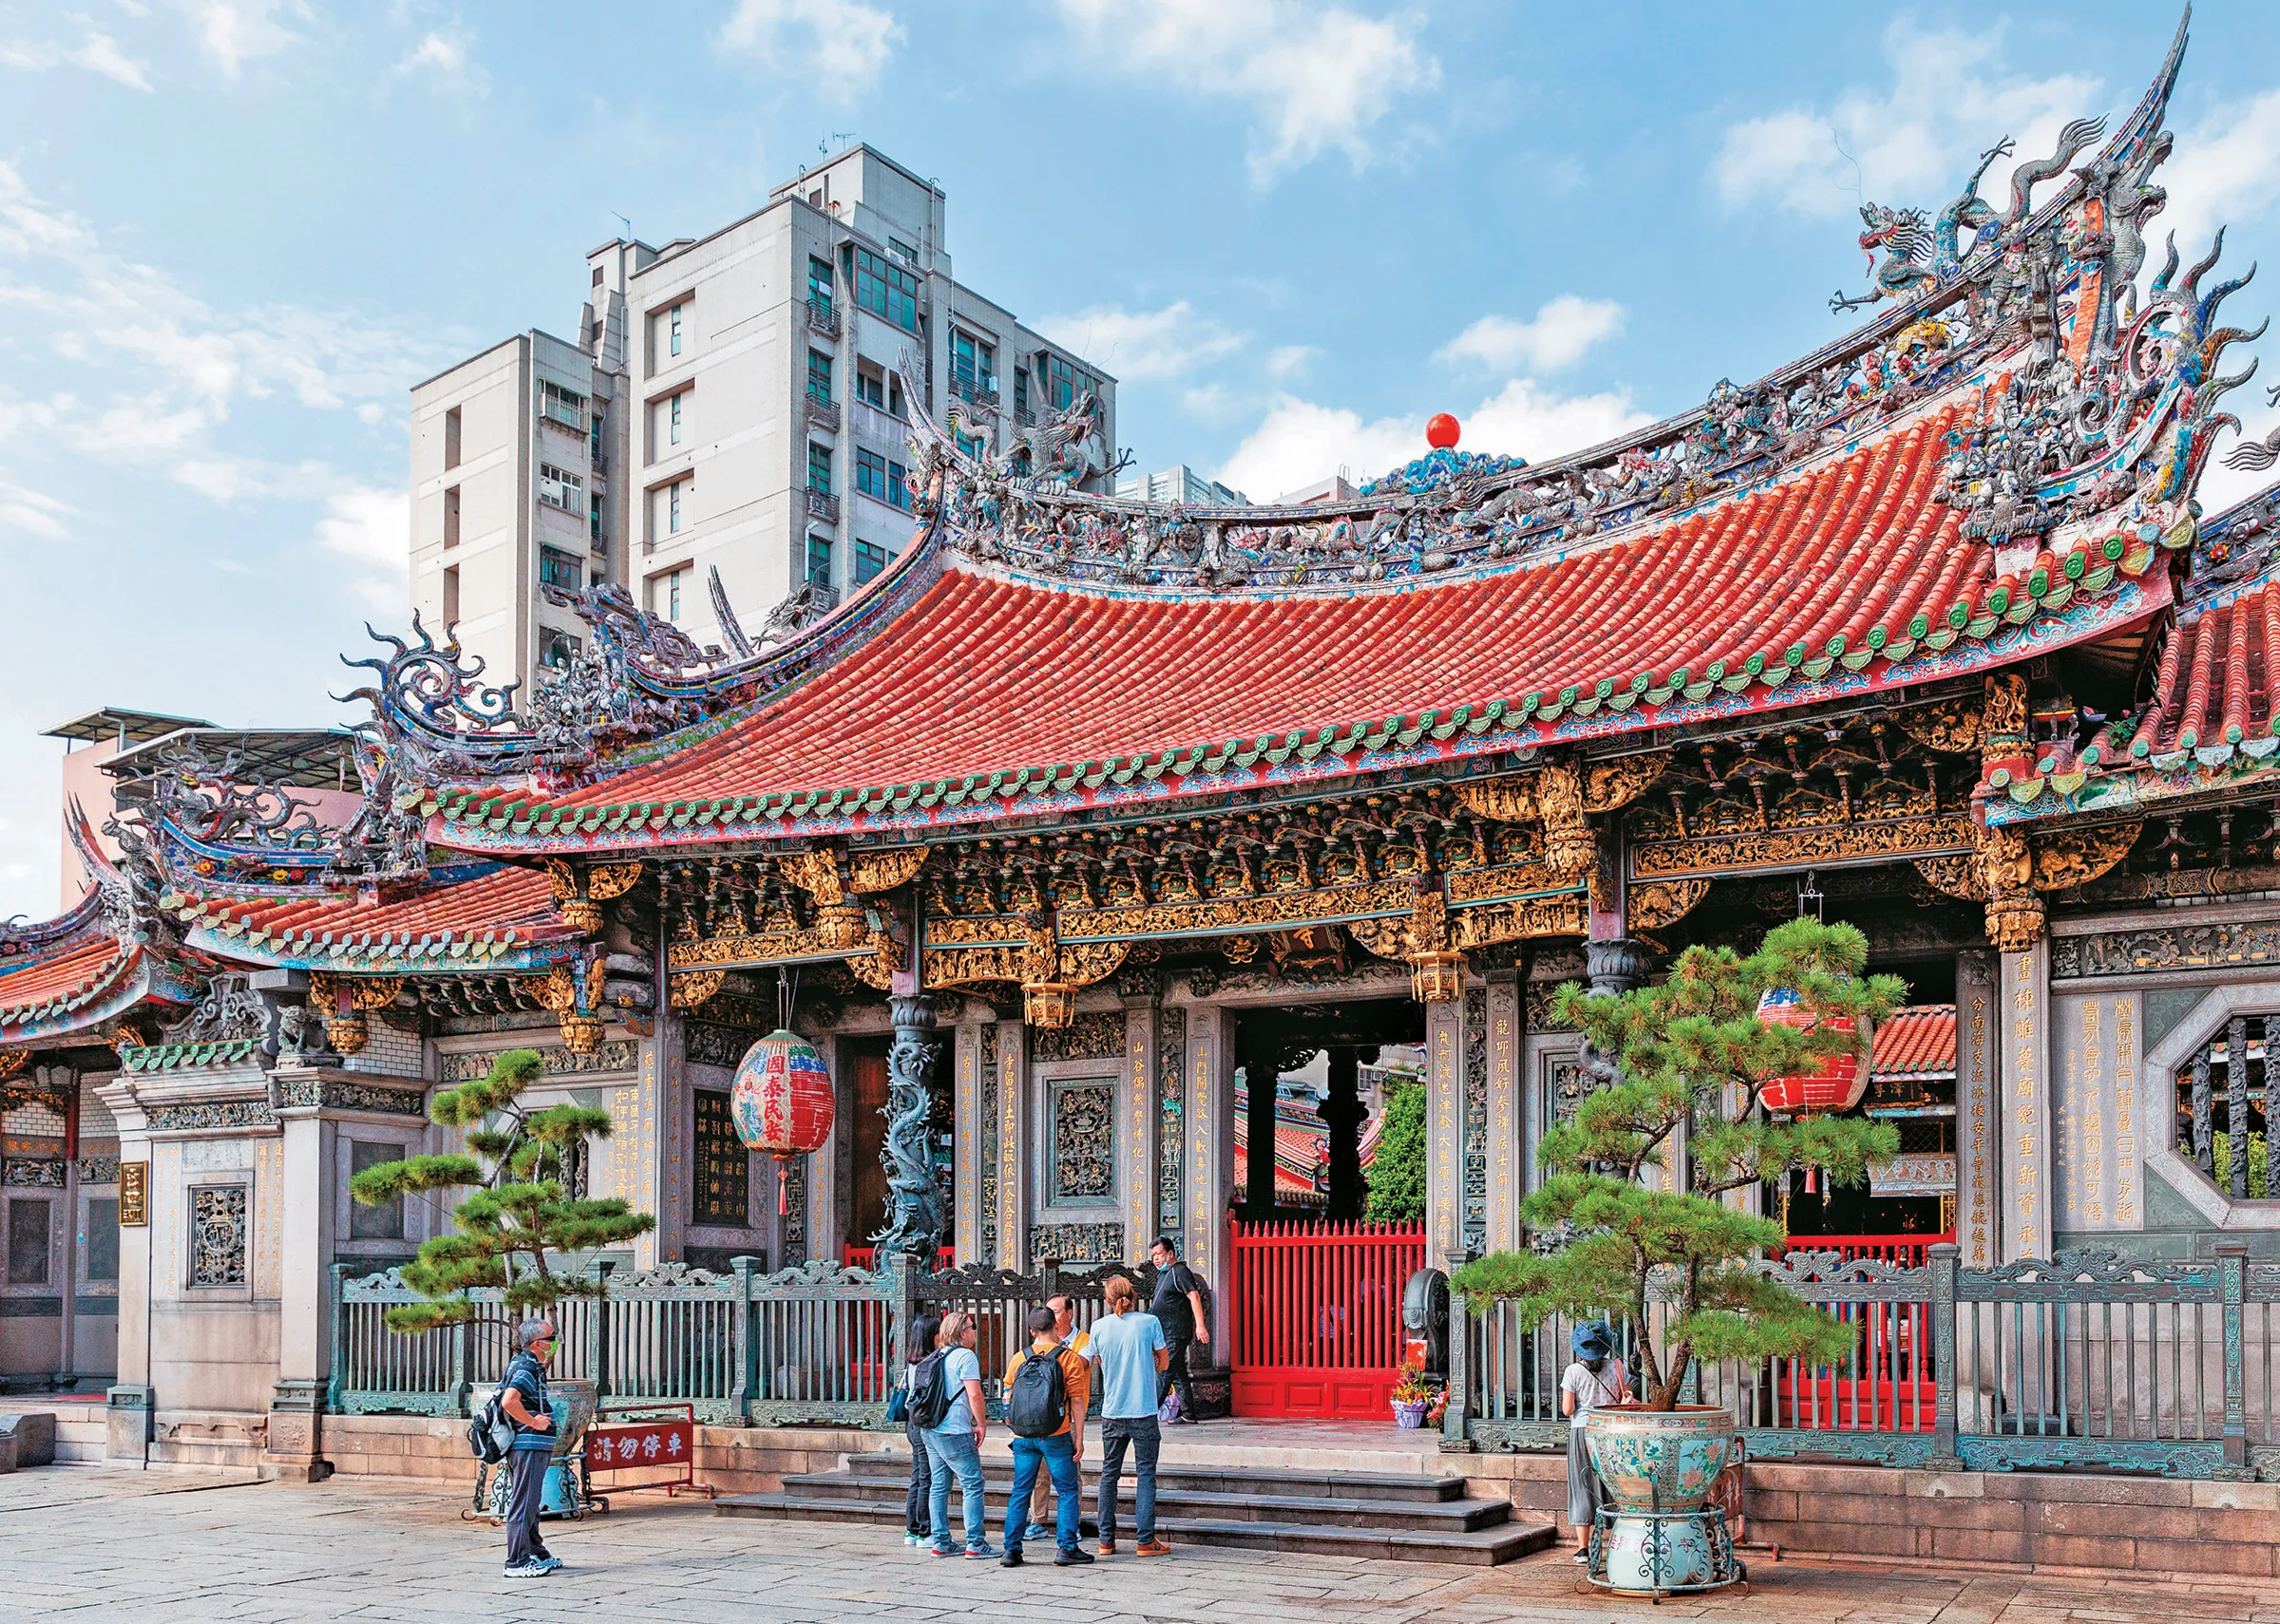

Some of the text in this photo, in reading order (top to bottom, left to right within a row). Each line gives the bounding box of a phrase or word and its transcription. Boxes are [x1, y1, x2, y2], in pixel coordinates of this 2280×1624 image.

[763, 1055, 786, 1142] 國泰民安
[594, 1432, 683, 1462] 請勿停車
